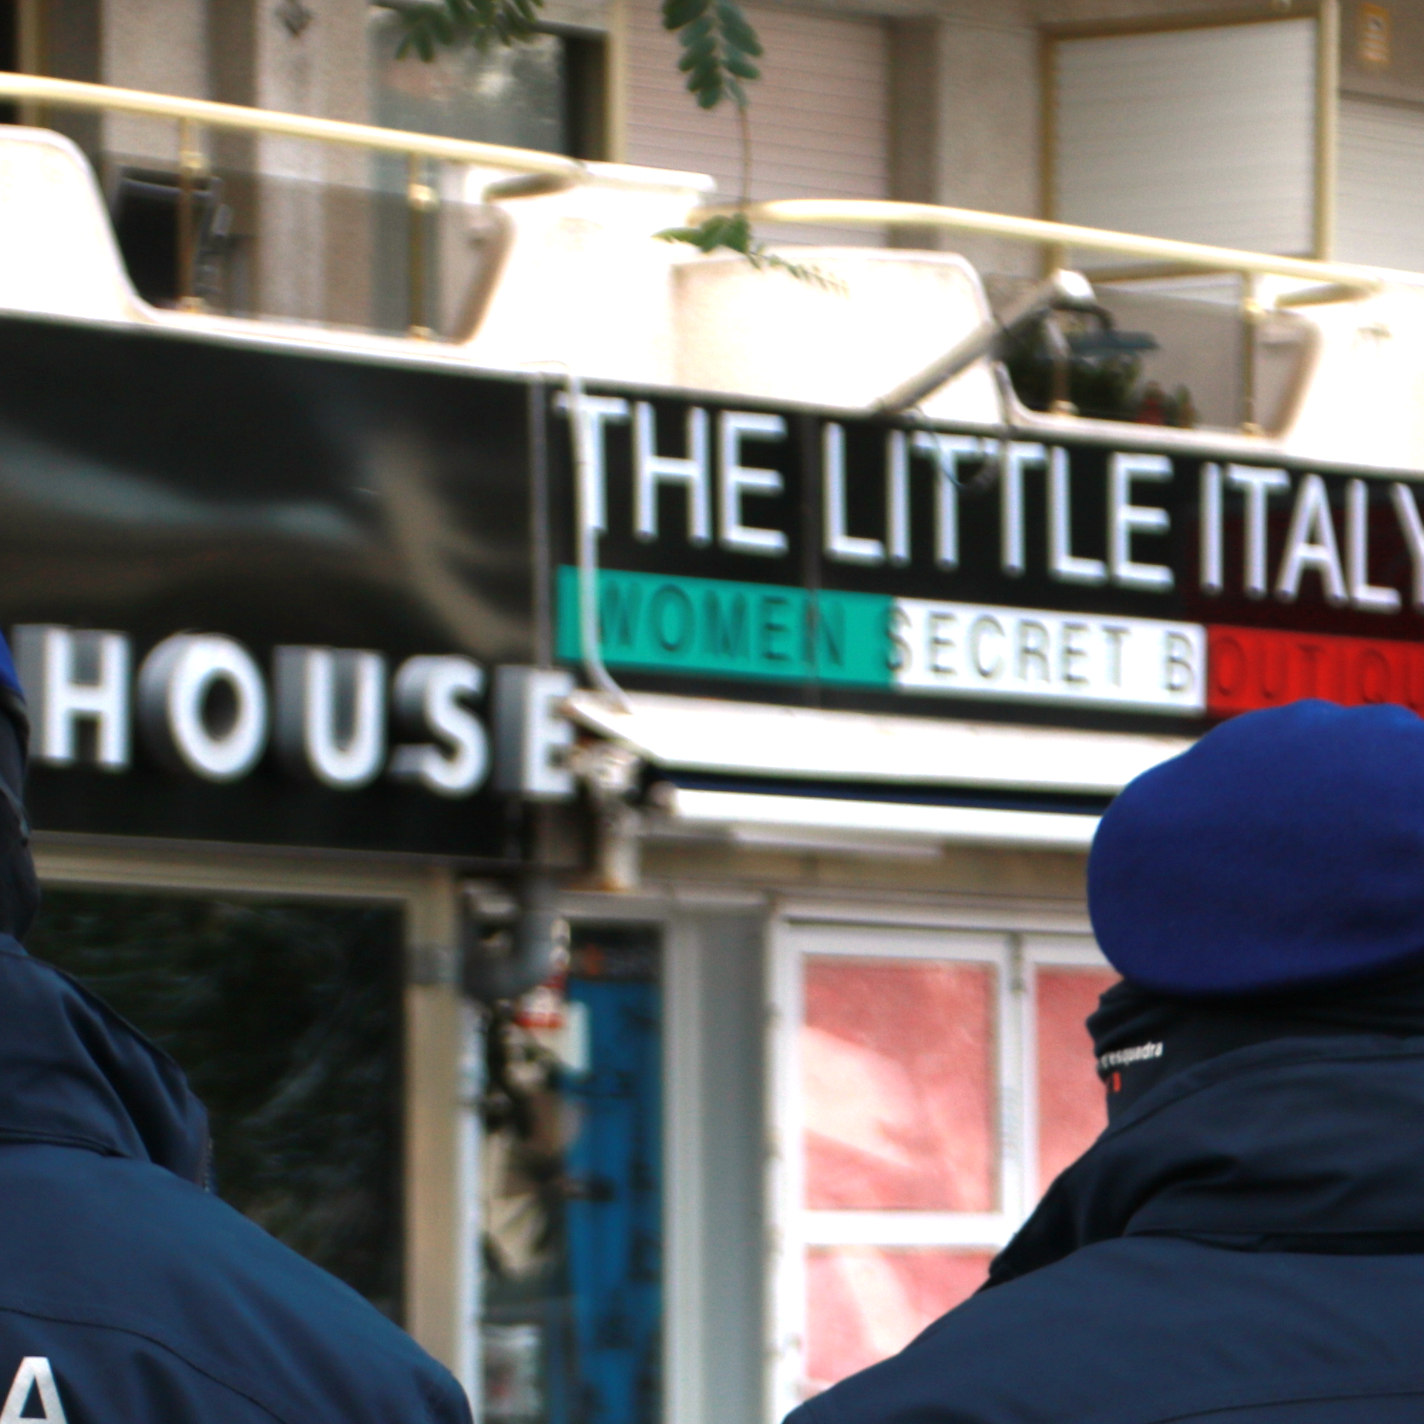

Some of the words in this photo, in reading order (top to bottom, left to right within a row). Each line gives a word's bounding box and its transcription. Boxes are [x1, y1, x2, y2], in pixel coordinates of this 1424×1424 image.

[554, 390, 789, 558] THE
[822, 422, 1175, 592] LITTLE
[24, 622, 576, 798] HOUSE
[598, 578, 850, 668] WOMEN
[886, 602, 1133, 690] SECRET
